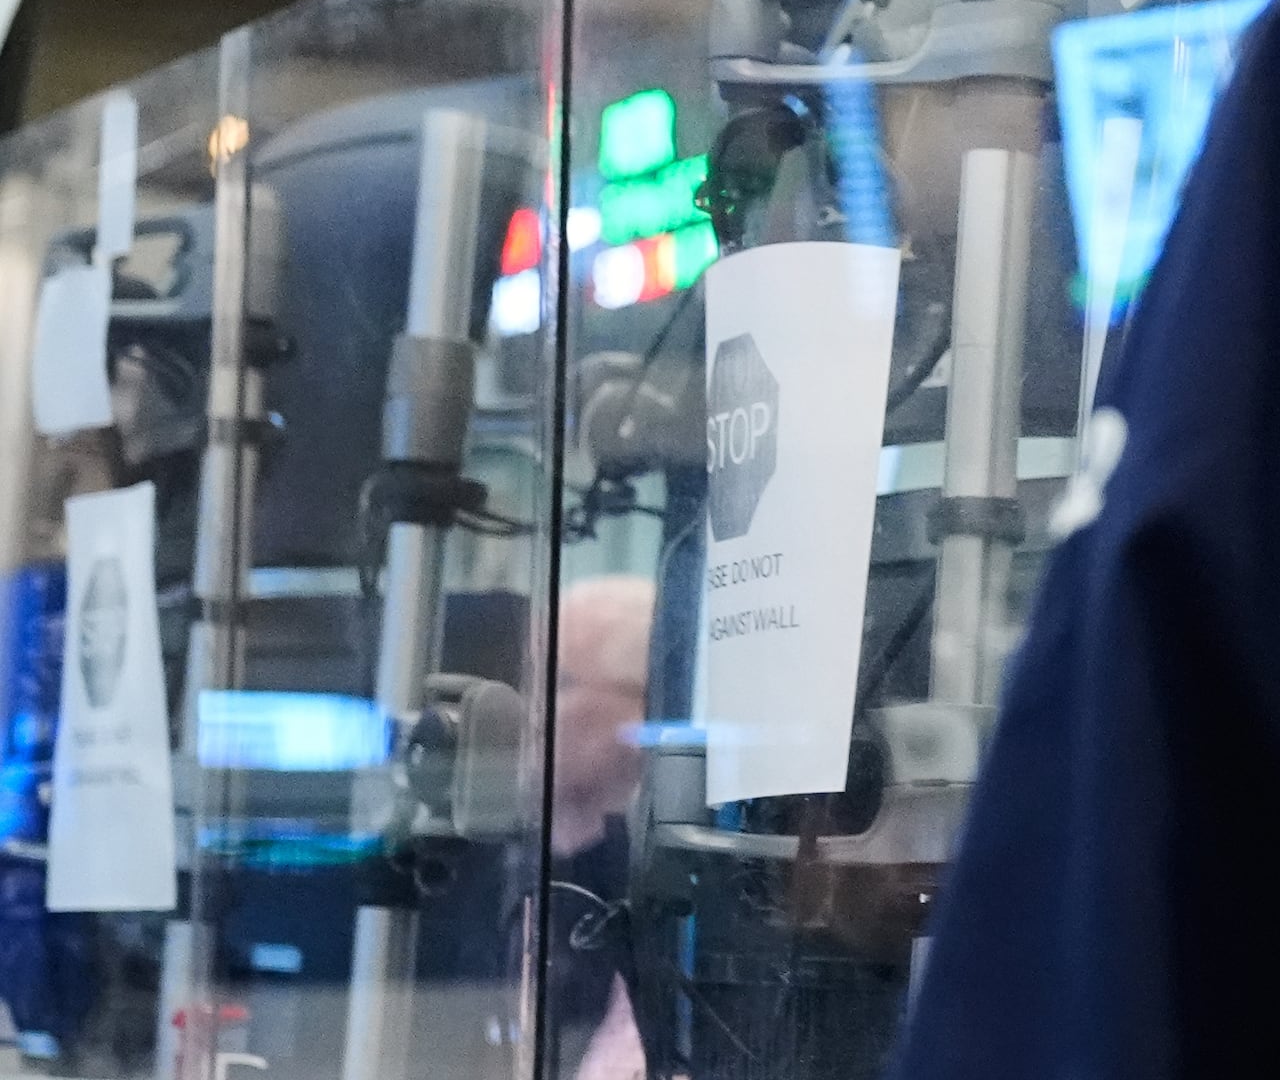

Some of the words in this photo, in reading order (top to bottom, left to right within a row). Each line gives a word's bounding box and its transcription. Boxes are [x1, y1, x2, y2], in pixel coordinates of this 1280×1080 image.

[707, 401, 770, 474] STOP
[731, 560, 748, 584] DO
[750, 553, 783, 579] NOT
[752, 605, 800, 631] WALL
